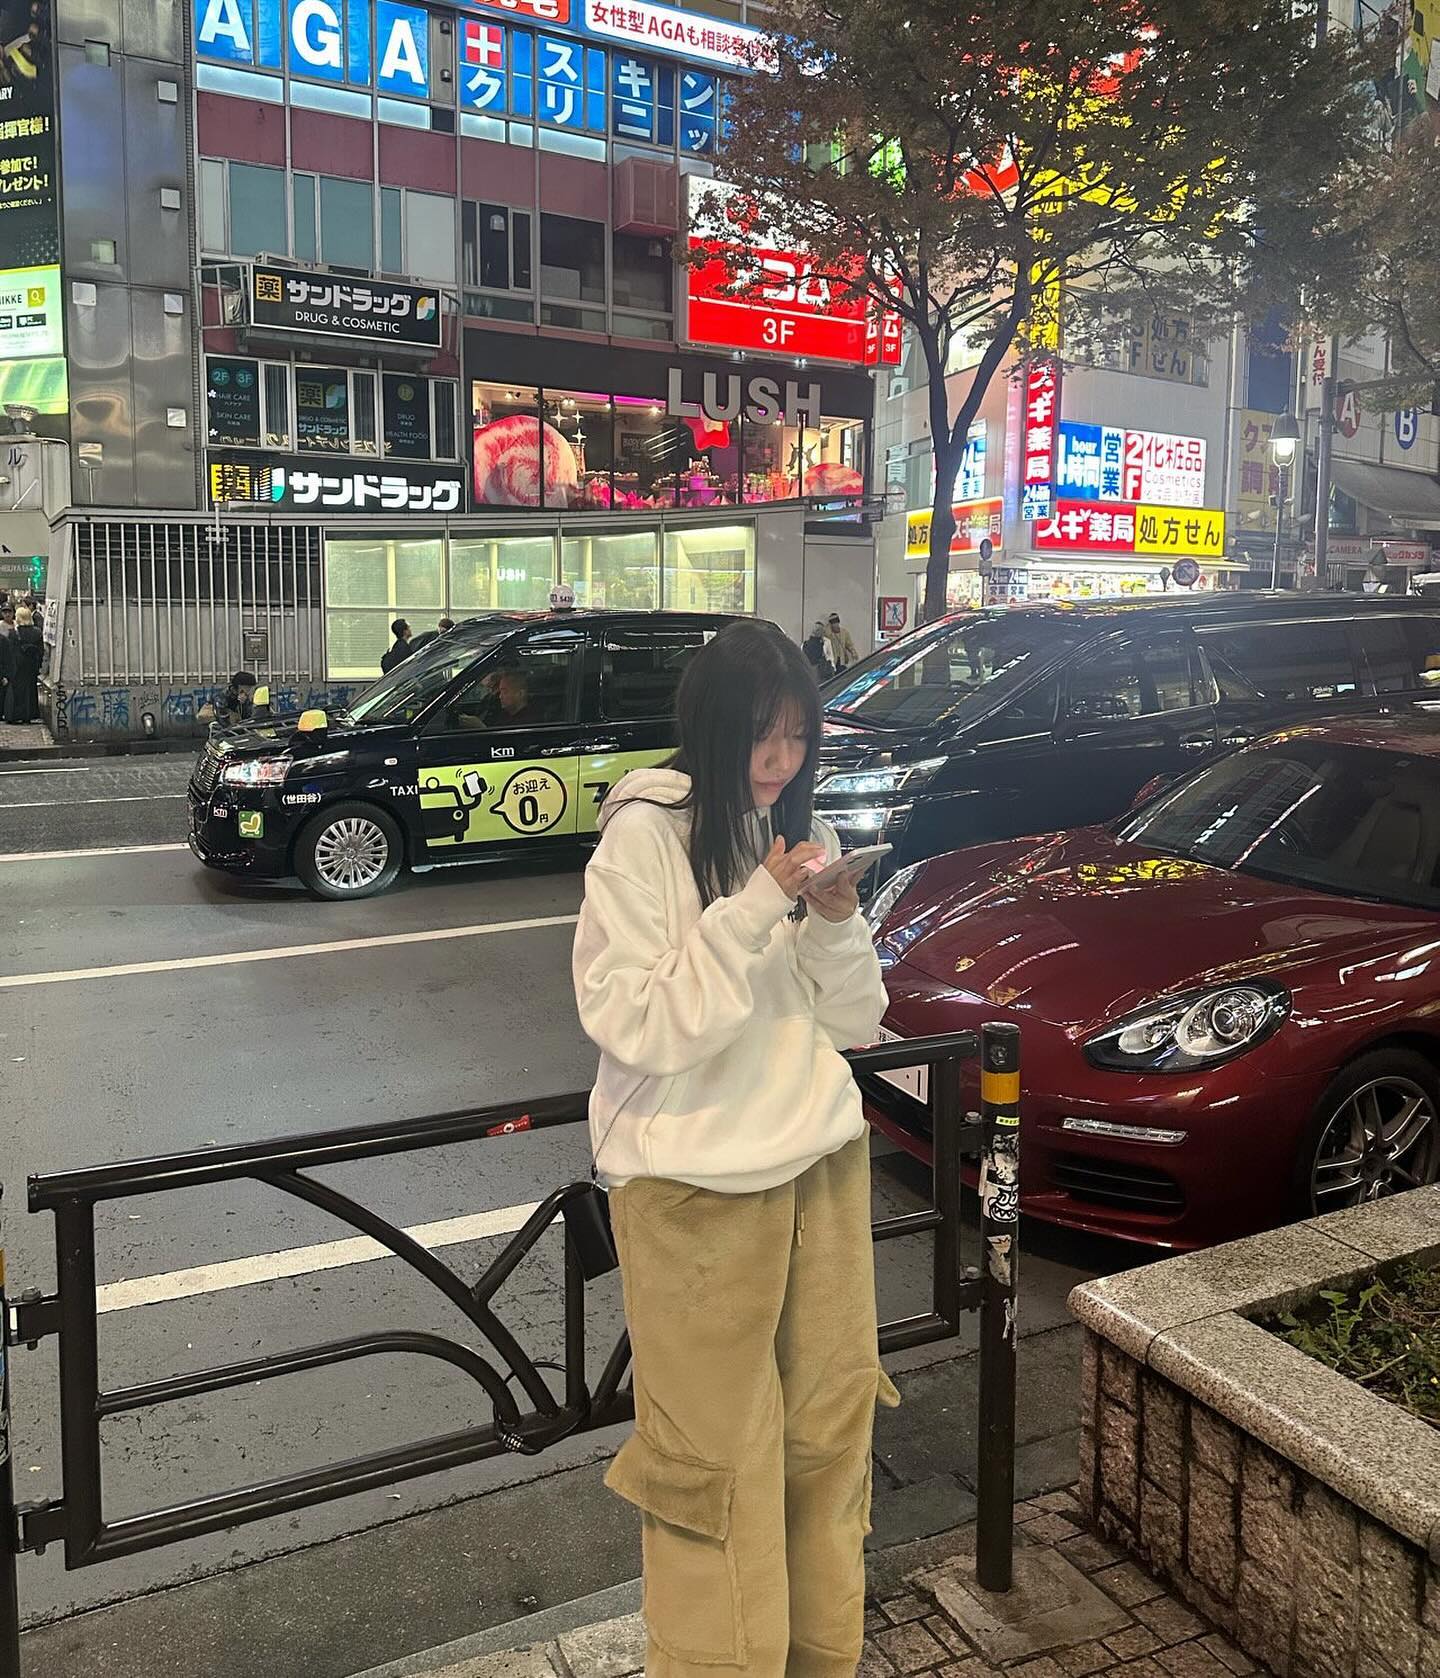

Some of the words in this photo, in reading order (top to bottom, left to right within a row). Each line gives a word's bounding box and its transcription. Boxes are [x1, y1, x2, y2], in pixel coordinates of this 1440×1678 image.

[199, 0, 426, 85] AGA
[0, 174, 49, 193] レゼント!
[0, 294, 22, 305] IKKE
[258, 277, 280, 299] 薬
[286, 279, 411, 317] サンドラッグ
[295, 311, 328, 325] DRUG
[331, 315, 341, 326] &
[342, 317, 400, 333] COSMETIC
[763, 318, 796, 345] 3F
[885, 344, 898, 353] 3F
[214, 371, 229, 382] 2F
[238, 373, 253, 384] 3F
[668, 368, 820, 428] LUSH
[1340, 391, 1357, 429] A
[1399, 410, 1413, 442] B
[1102, 432, 1121, 497] 営業
[1126, 433, 1145, 500] 2F
[1146, 436, 1203, 472] 化粧品
[288, 471, 462, 511] サンドラッグ
[1144, 469, 1201, 488] Cosmetics
[1037, 508, 1135, 544] スギ薬局
[1139, 514, 1221, 546] 処方せん
[491, 746, 514, 758] km
[282, 793, 322, 805] (世田谷)
[390, 785, 418, 796] TAXI
[512, 777, 551, 796] お迎え
[213, 807, 228, 818] km
